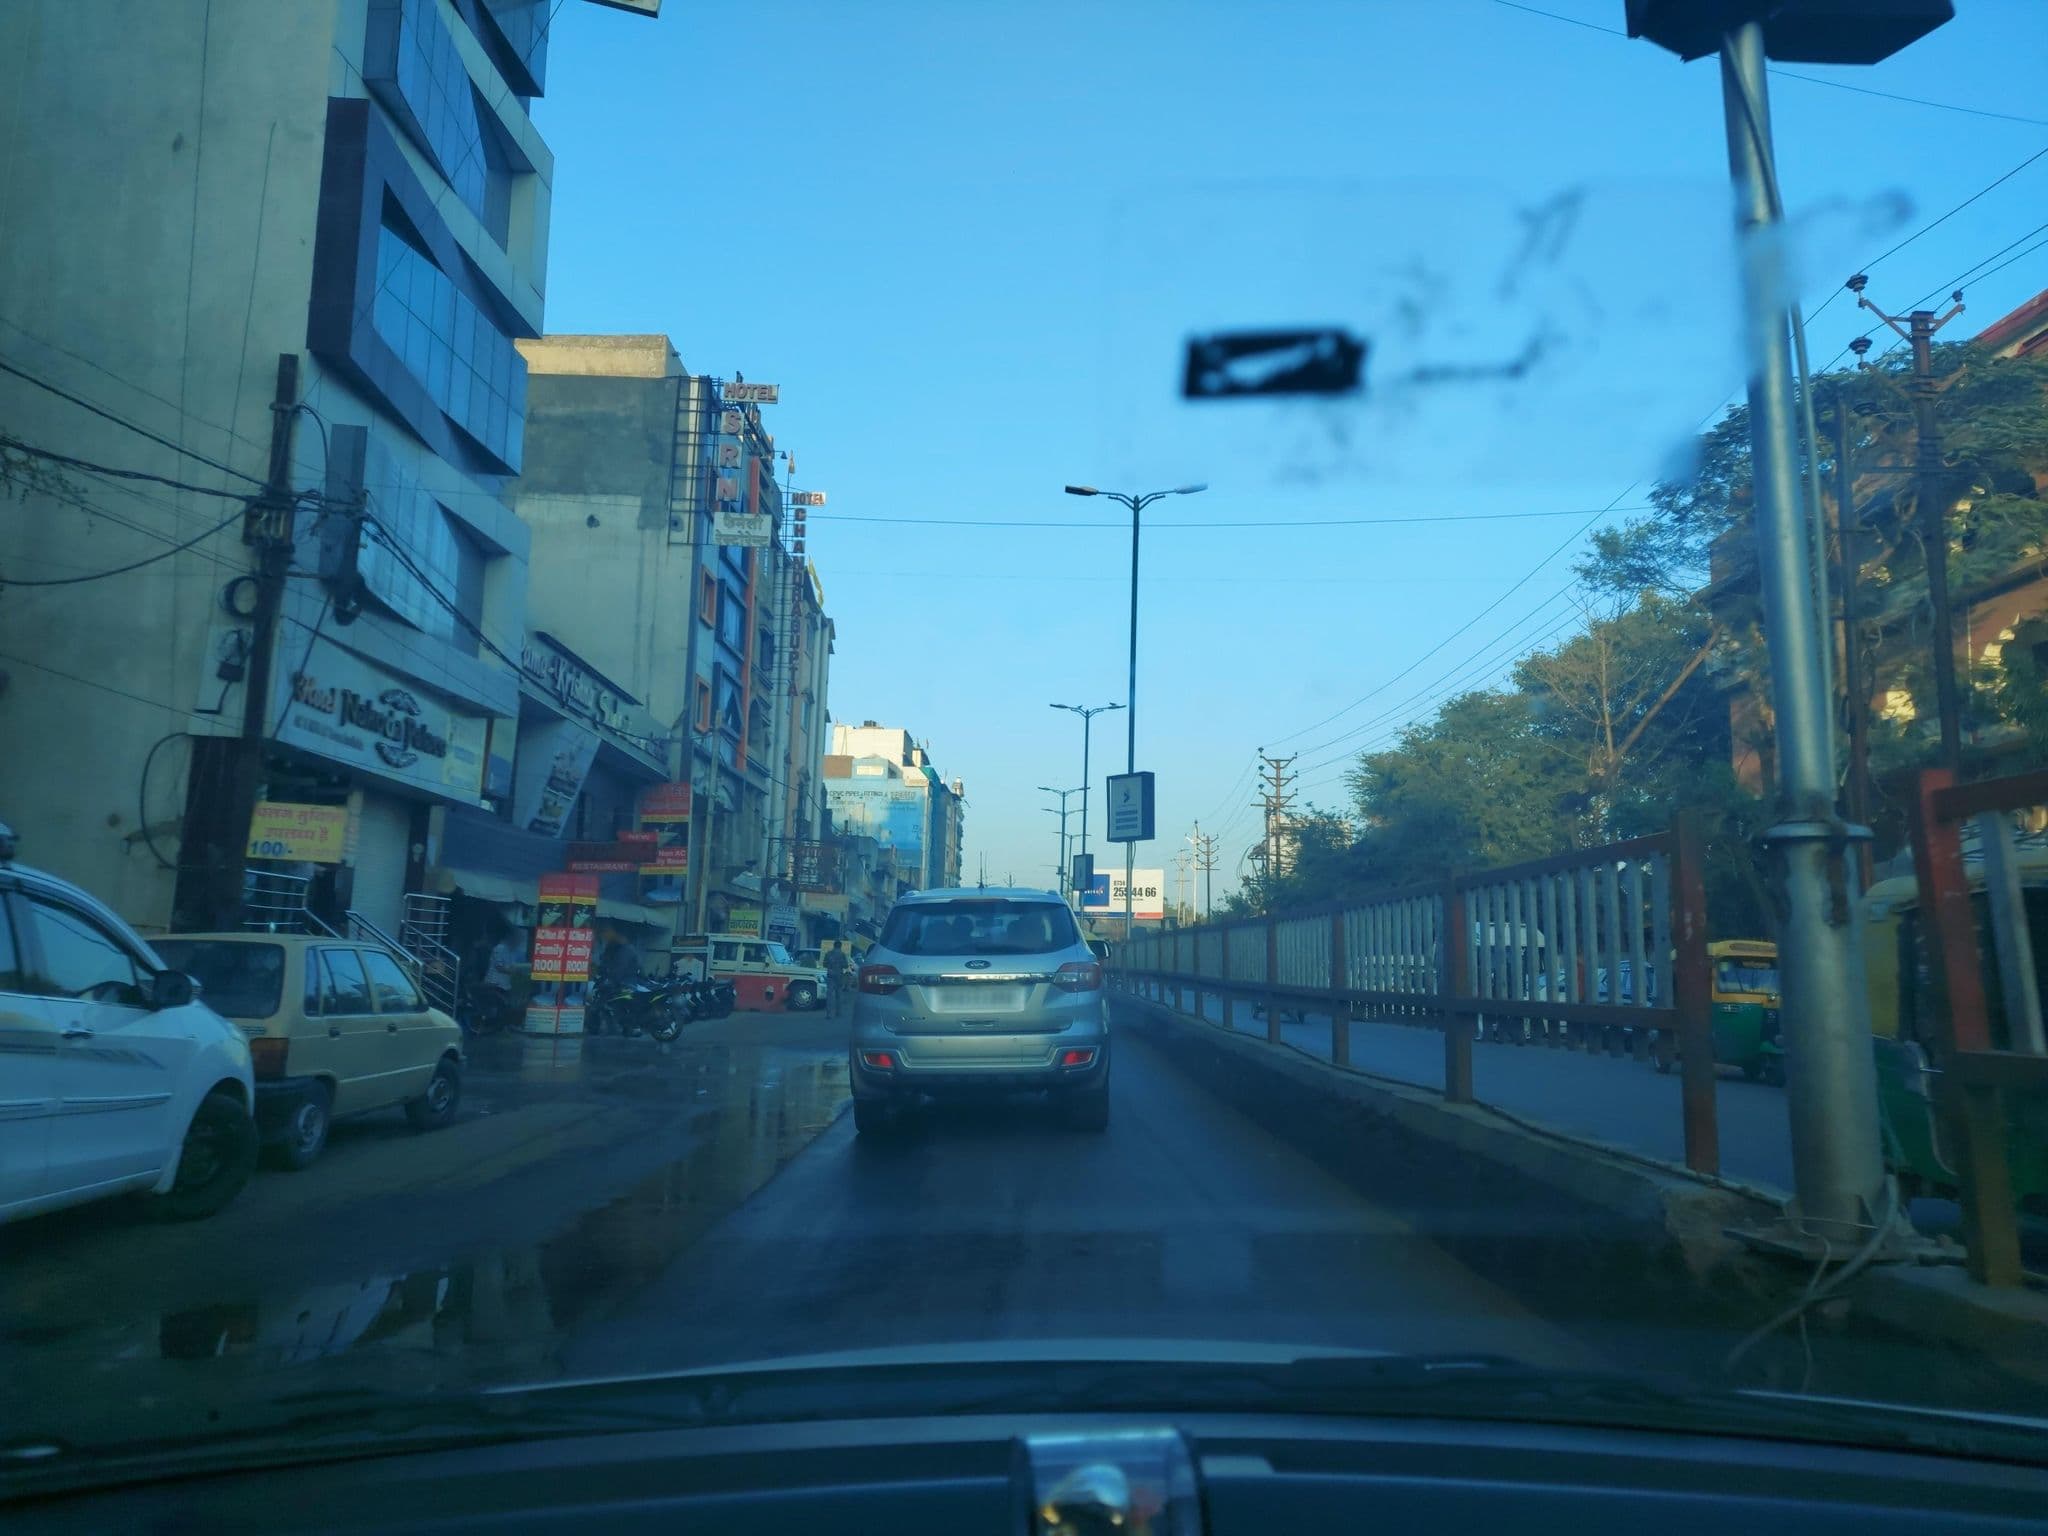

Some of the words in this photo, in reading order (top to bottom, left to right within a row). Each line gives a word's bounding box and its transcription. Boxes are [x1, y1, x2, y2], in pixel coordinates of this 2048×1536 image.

[724, 383, 777, 401] HOTEL
[792, 493, 825, 505] HOTEL
[571, 863, 629, 872] RESTAURANT
[1145, 887, 1157, 897] 66
[534, 943, 565, 958] Family
[567, 944, 591, 959] Family
[534, 959, 561, 971] ROOM
[566, 960, 589, 972] ROOM
